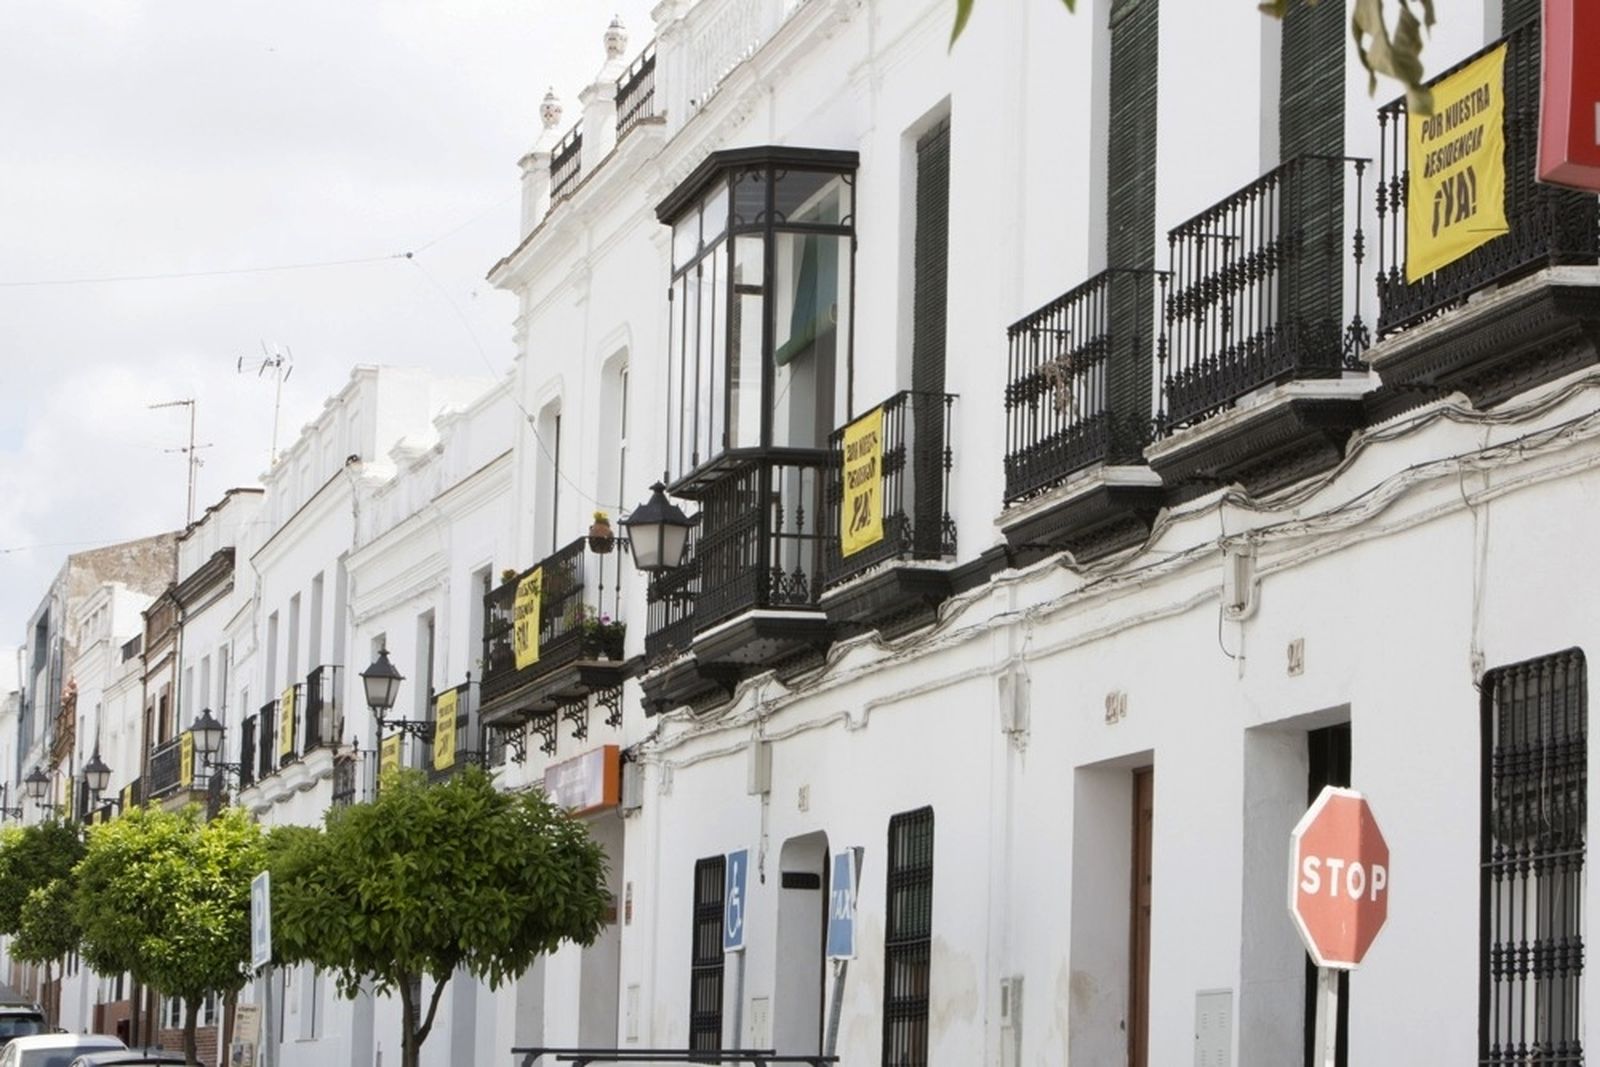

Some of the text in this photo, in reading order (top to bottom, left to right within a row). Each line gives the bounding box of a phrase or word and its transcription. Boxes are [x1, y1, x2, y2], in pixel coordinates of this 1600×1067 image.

[1421, 82, 1490, 144] POR NUESTRA
[1431, 165, 1478, 238] ¡YA!
[1300, 855, 1387, 902] STOP
